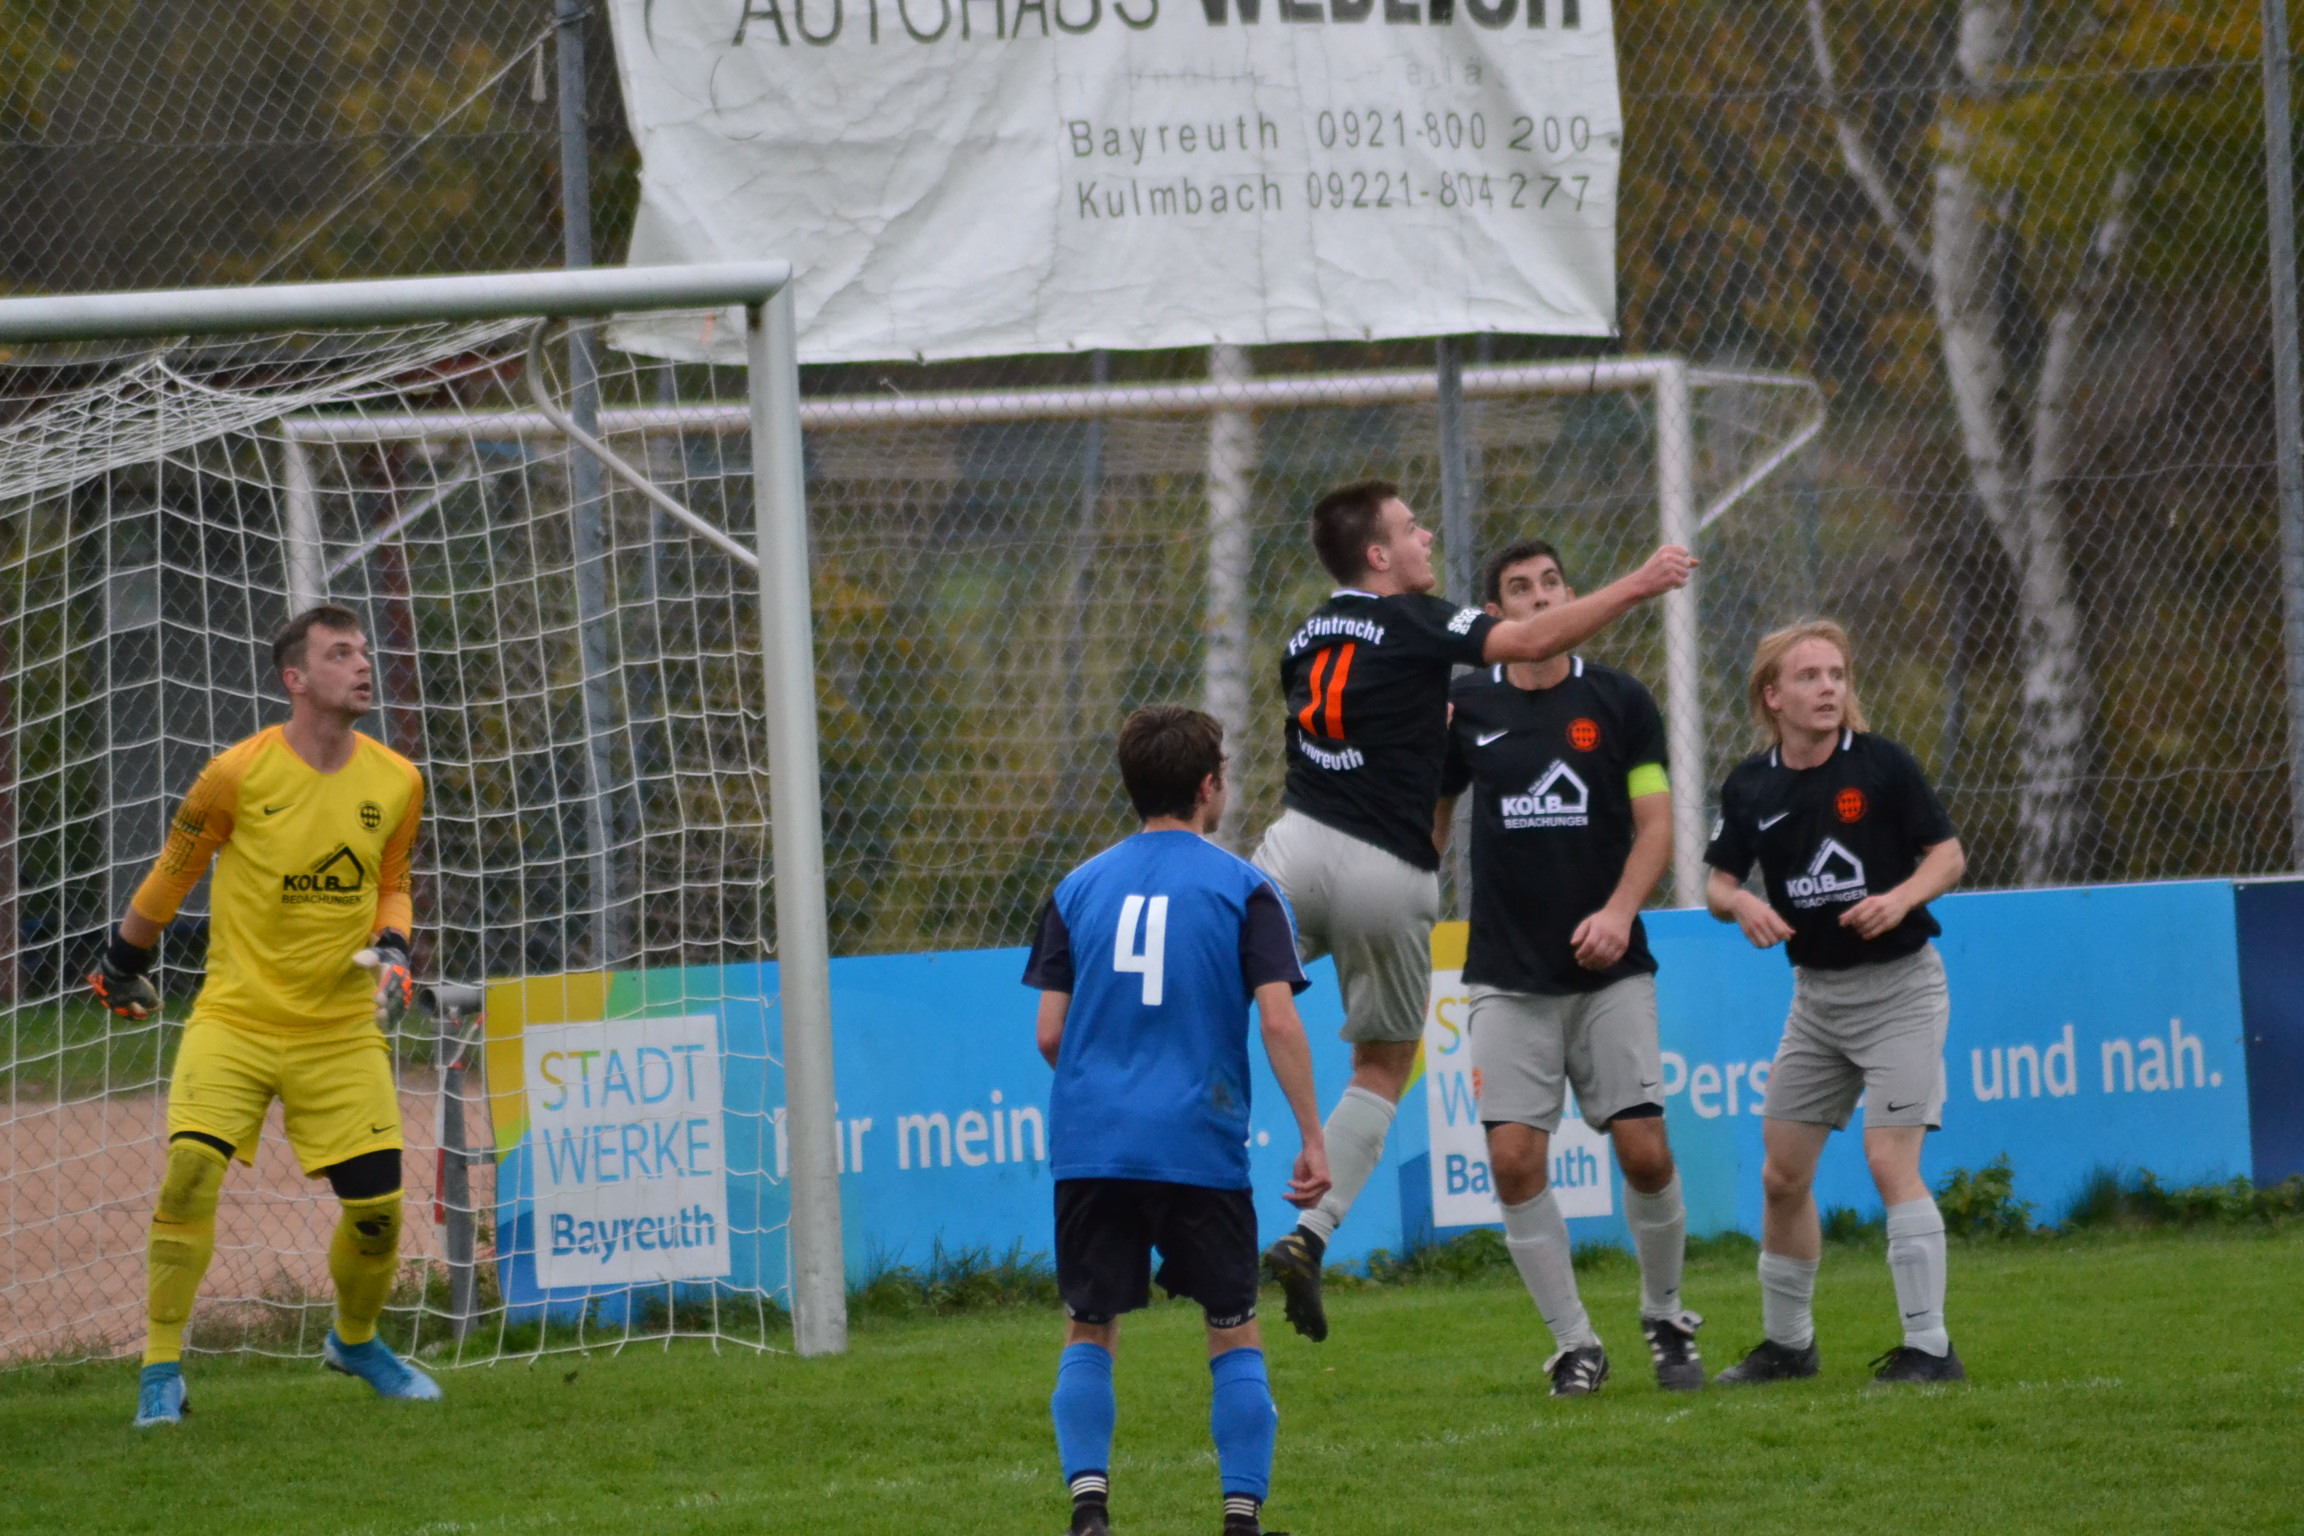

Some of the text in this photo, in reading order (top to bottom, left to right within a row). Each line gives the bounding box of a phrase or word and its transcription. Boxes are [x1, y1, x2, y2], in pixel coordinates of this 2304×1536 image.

[1068, 112, 1279, 165] Bayreuth
[1509, 116, 1590, 153] 200
[1076, 174, 1282, 219] Kulmbach
[1509, 172, 1591, 212] 277
[1289, 617, 1385, 656] FC Eintracht
[1299, 642, 1355, 740] 11
[1299, 729, 1364, 771] yreuth
[1501, 795, 1562, 817] KOLB
[1504, 815, 1588, 829] BEDACHUNGEN
[282, 875, 340, 892] KOLB
[282, 894, 361, 905] BEDACHUNGEN
[1786, 874, 1836, 898] KOLB
[1113, 895, 1169, 1006] 4
[540, 1044, 704, 1112] STADT
[1971, 1023, 2078, 1102] und
[2101, 1017, 2222, 1093] nah.
[543, 1118, 713, 1186] WERKE
[1446, 1146, 1598, 1204] Bauth
[550, 1203, 716, 1265] Bayreuth
